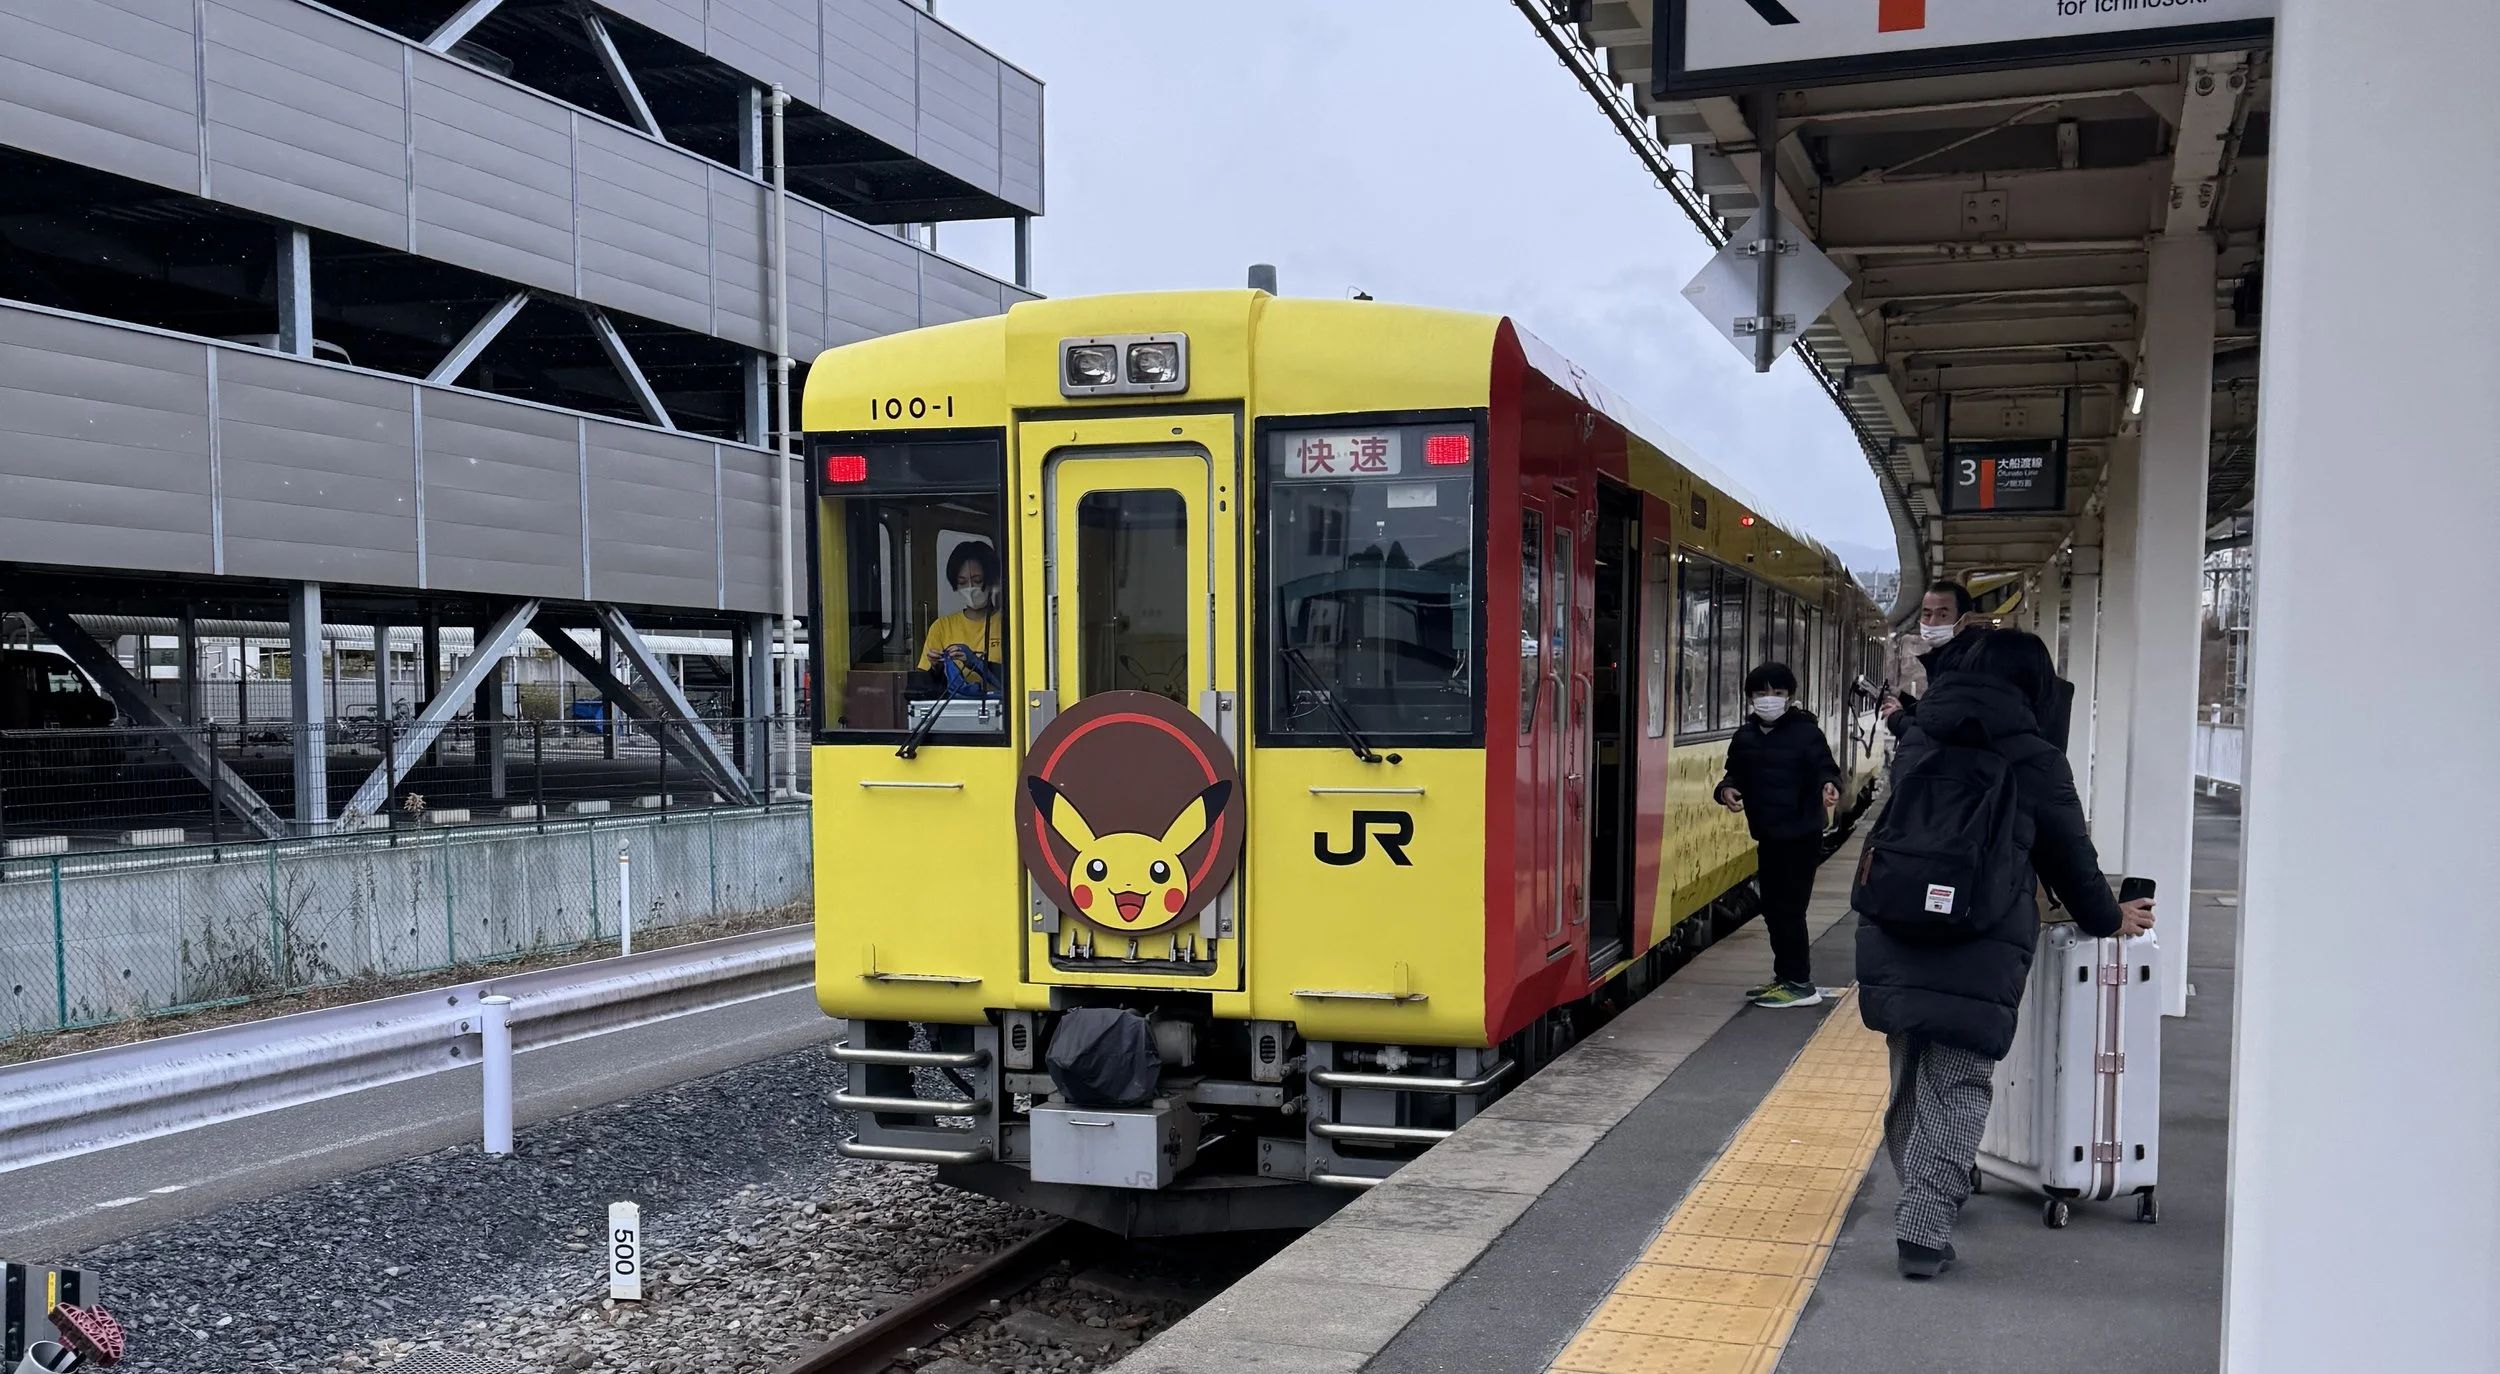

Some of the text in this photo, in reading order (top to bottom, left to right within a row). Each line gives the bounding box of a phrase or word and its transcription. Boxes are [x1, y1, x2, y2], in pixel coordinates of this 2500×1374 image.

[2057, 0, 2087, 16] for
[872, 396, 953, 420] 100-1
[1297, 437, 1388, 474] 快速
[1997, 457, 2043, 470] 大船渡線
[1959, 459, 1977, 486] 3
[1314, 810, 1414, 866] JR
[1124, 1171, 1153, 1187] JR
[614, 1228, 634, 1275] 500
